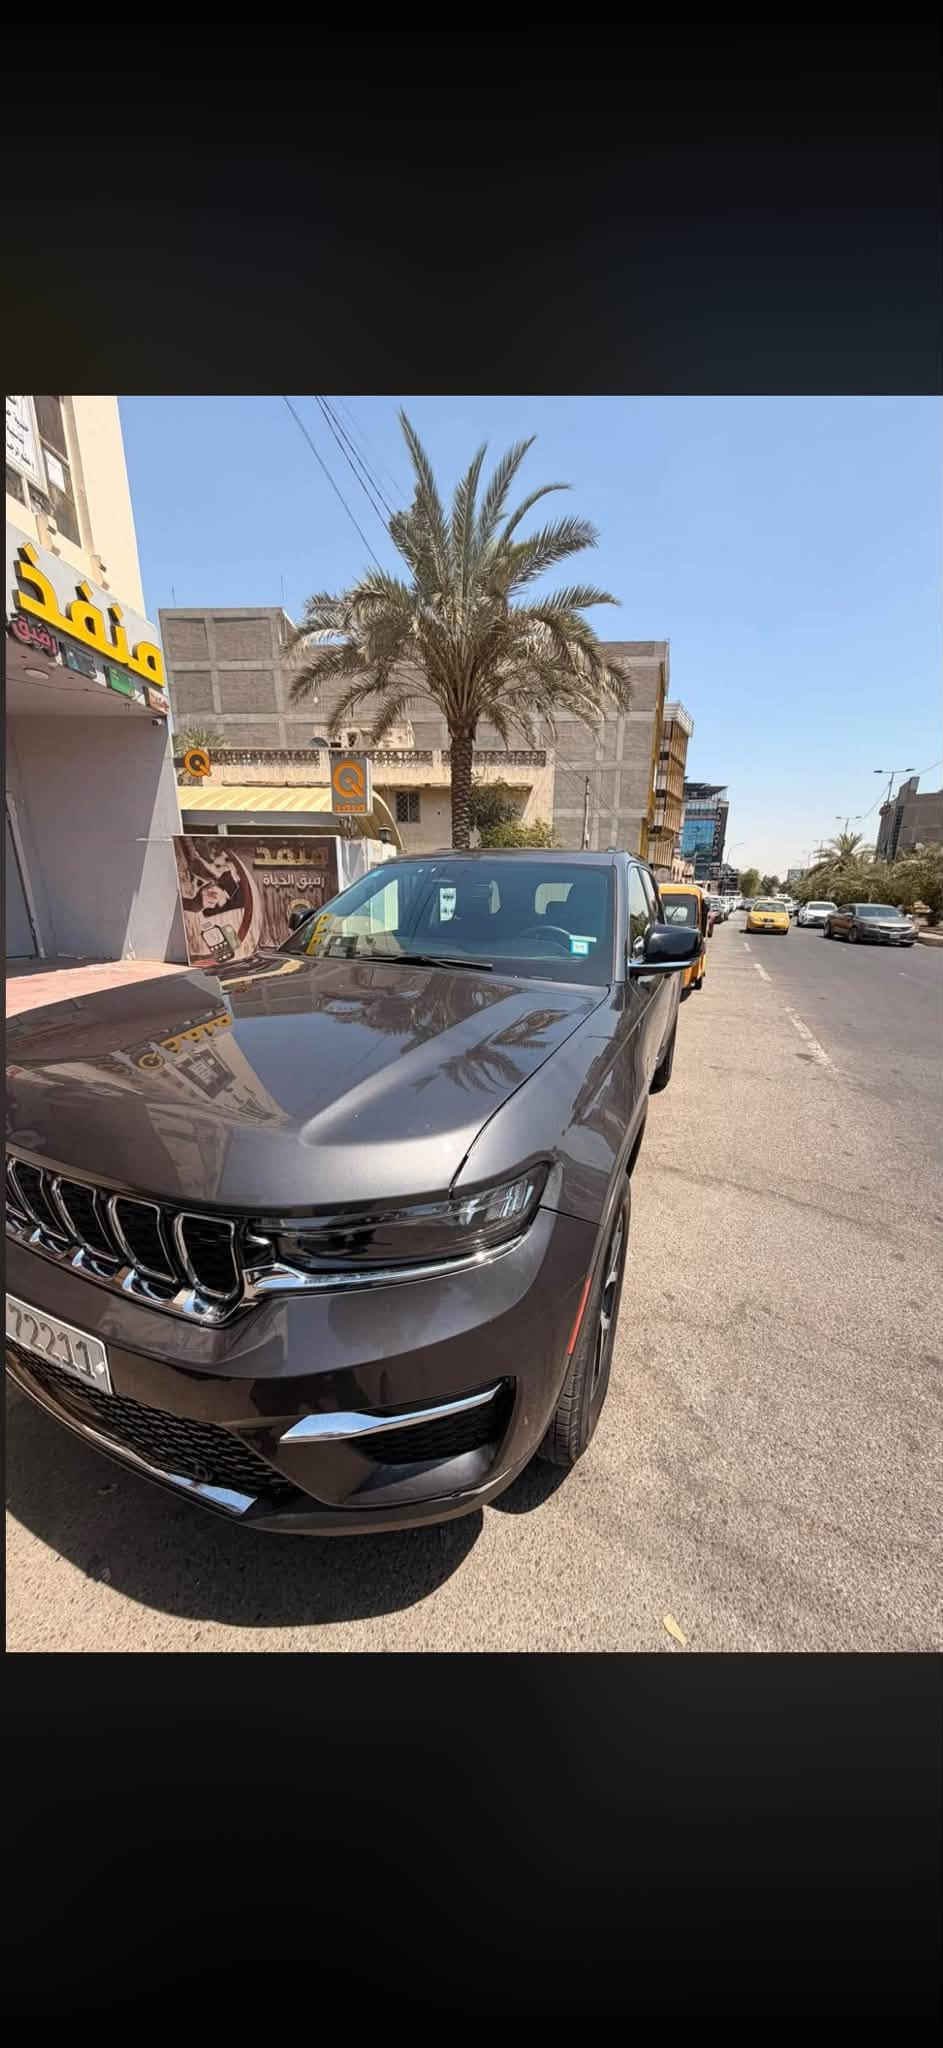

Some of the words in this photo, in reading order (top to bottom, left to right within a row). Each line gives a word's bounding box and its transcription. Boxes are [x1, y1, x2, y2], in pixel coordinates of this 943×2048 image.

[10, 614, 58, 657] رفيق
[14, 543, 165, 687] منفذ
[333, 760, 366, 798] Q
[263, 873, 295, 888] الحياة
[8, 1302, 96, 1380] 72211
